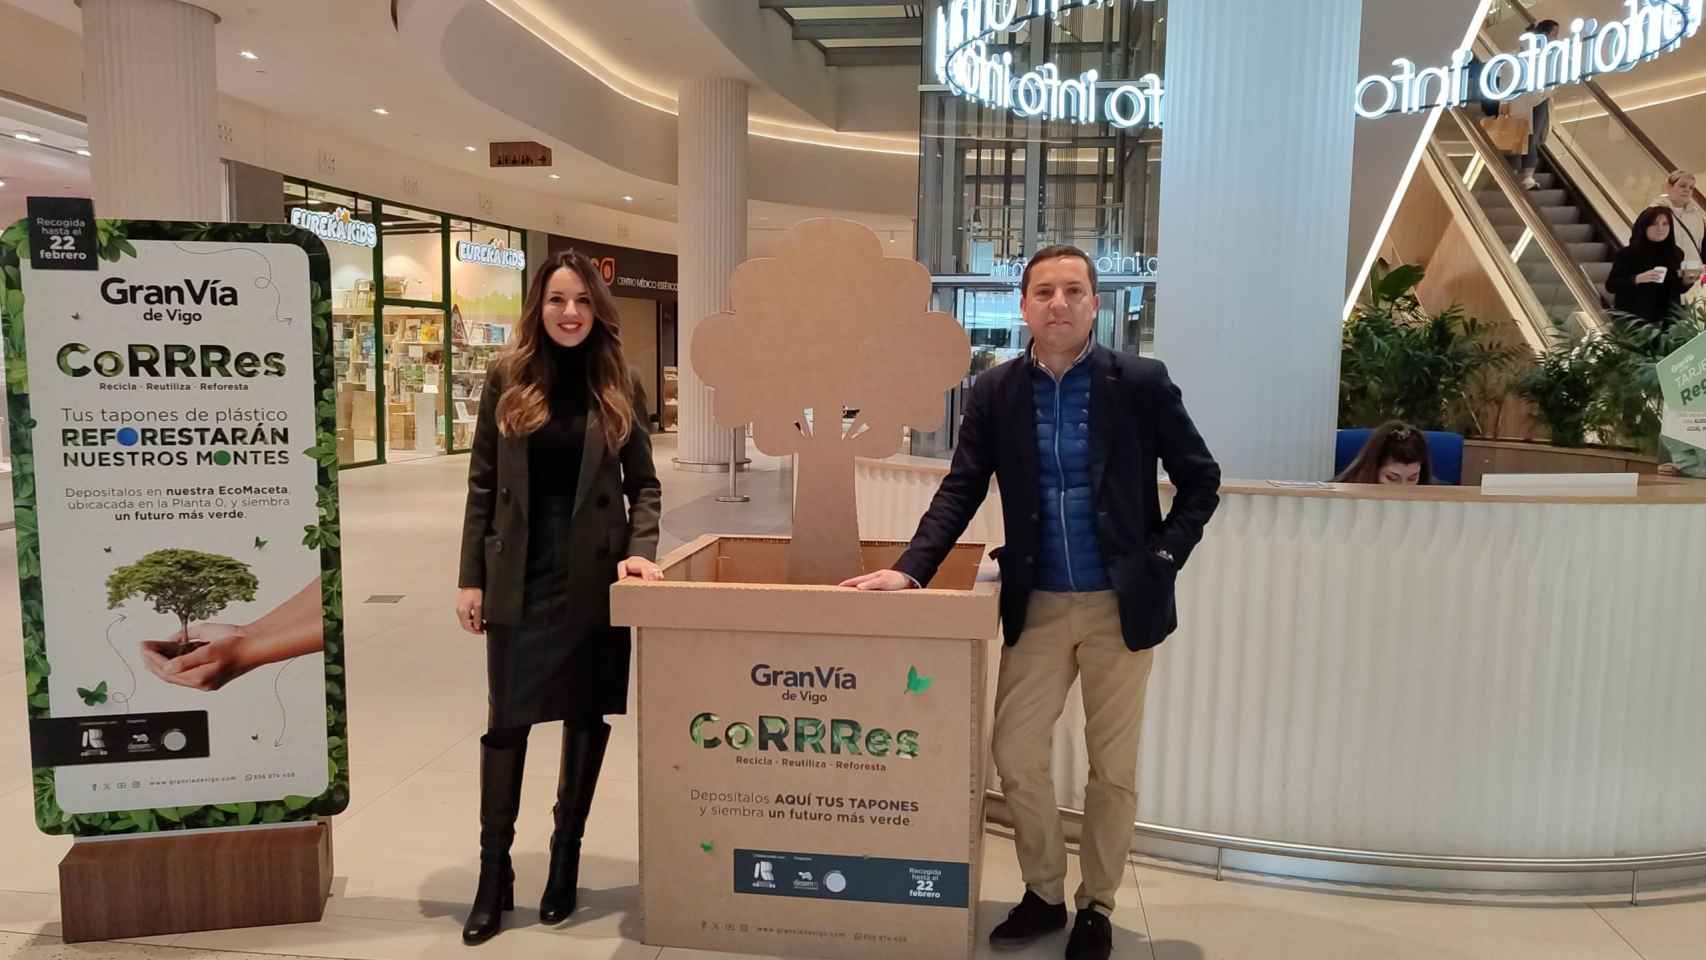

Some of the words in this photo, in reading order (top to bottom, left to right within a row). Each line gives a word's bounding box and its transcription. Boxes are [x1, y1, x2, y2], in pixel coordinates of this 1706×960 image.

[37, 217, 86, 229] Recogida
[41, 227, 70, 236] hasta
[72, 227, 82, 236] el
[49, 236, 76, 250] 22
[39, 249, 87, 260] febrero
[100, 277, 239, 307] GranVía
[143, 308, 163, 322] de
[166, 309, 202, 325] Vigo
[56, 342, 288, 378] CoRRRes
[99, 382, 137, 391] Recicla
[146, 382, 192, 391] Reutiliza
[200, 382, 249, 391] Reforesta
[61, 408, 94, 422] Tus
[101, 409, 179, 425] tapones
[185, 408, 209, 422] de
[215, 408, 288, 425] plástico
[61, 423, 289, 447] REFORESTARÁN
[63, 451, 188, 467] NUESTROS
[196, 450, 289, 466] MONTES
[146, 489, 162, 498] en
[166, 487, 214, 497] nuestra
[68, 499, 134, 510] ubicacada
[138, 500, 153, 509] en
[157, 499, 168, 509] la
[172, 498, 211, 509] Planta
[231, 499, 238, 509] y
[241, 497, 290, 507] siembra
[114, 511, 131, 521] un
[135, 510, 175, 521] futuro
[178, 509, 204, 520] más
[751, 664, 857, 690] GranVía
[782, 689, 798, 701] de
[800, 691, 828, 705] Vigo
[689, 712, 919, 759] CoRRRes
[736, 755, 773, 766] Recicla
[782, 757, 827, 769] Reutiliza
[836, 760, 887, 772] Reforesta
[774, 793, 811, 806] AQUÍ
[815, 796, 845, 808] TUS
[849, 798, 920, 812] TAPONES
[699, 805, 706, 817] y
[711, 805, 764, 818] siembra
[768, 808, 786, 819] un
[789, 808, 832, 822] futuro
[837, 811, 865, 824] más
[909, 889, 941, 898] febrero
[916, 880, 934, 891] 22
